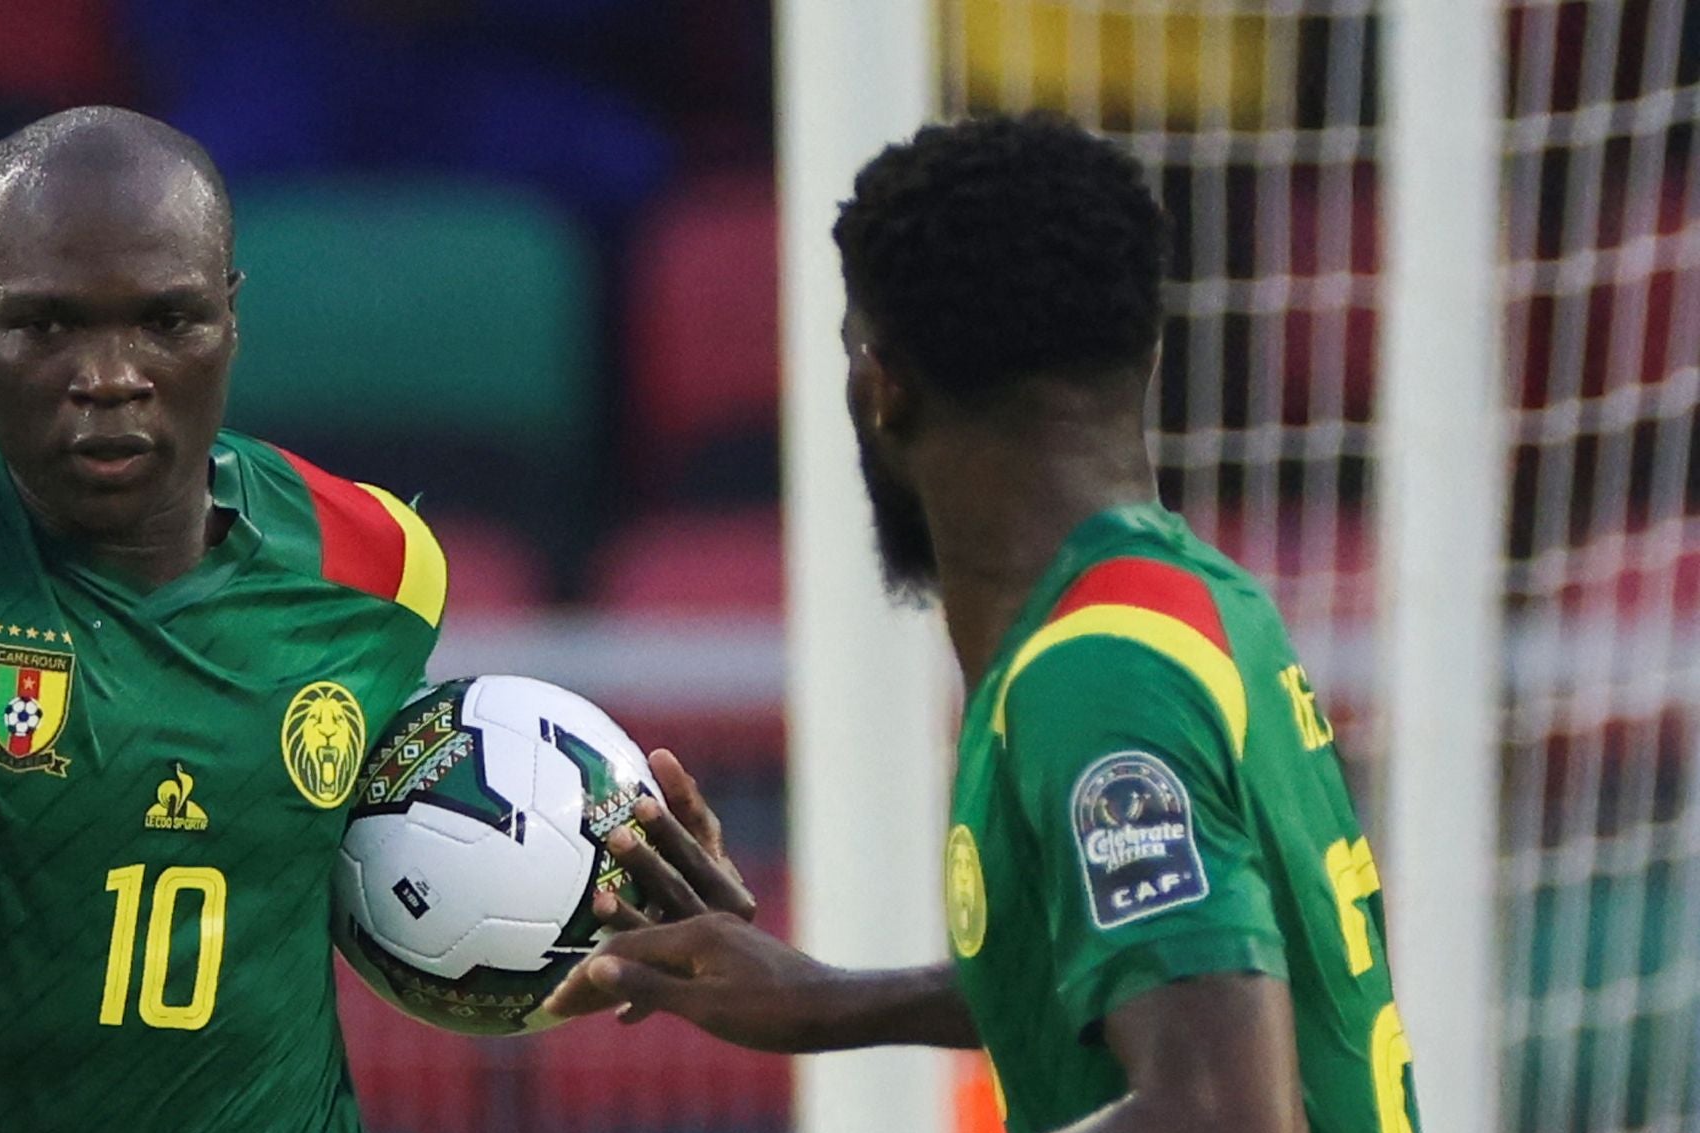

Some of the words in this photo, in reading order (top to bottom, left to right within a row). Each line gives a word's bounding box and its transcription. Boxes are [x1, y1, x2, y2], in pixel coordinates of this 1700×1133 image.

[1087, 822, 1185, 864] Celebrate
[1112, 873, 1181, 908] CAF
[99, 863, 227, 1031] 10
